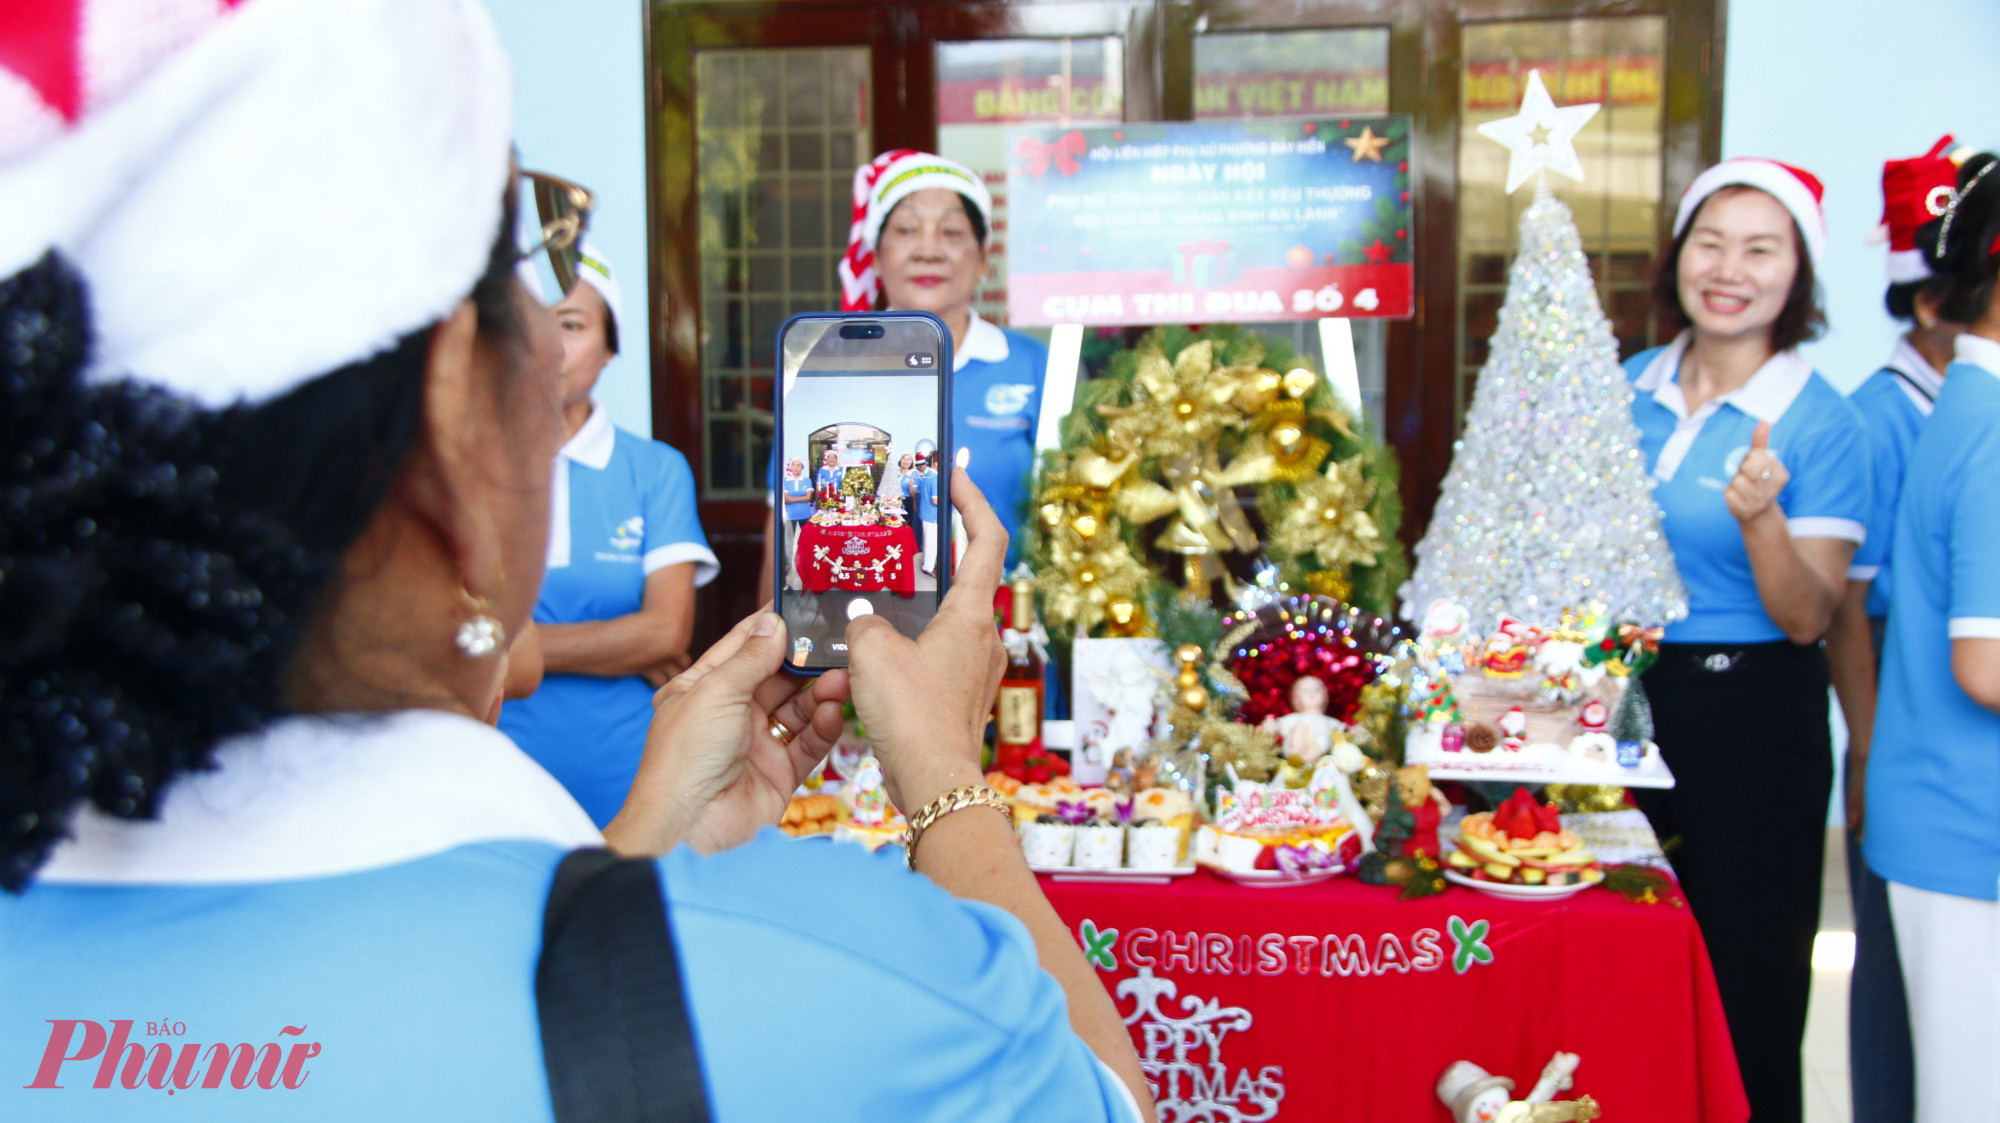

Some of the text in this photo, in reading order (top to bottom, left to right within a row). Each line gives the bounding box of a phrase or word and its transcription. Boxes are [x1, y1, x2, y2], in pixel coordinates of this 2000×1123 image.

[1150, 159, 1266, 184] NGÀY HỘI
[1042, 294, 1125, 322] CỤM
[1132, 292, 1194, 315] THI
[1291, 283, 1344, 313] SỐ
[1353, 288, 1379, 311] 4
[832, 643, 848, 651] VID
[1123, 927, 1444, 977] CHRISTMAS
[1140, 1022, 1238, 1069] PPY
